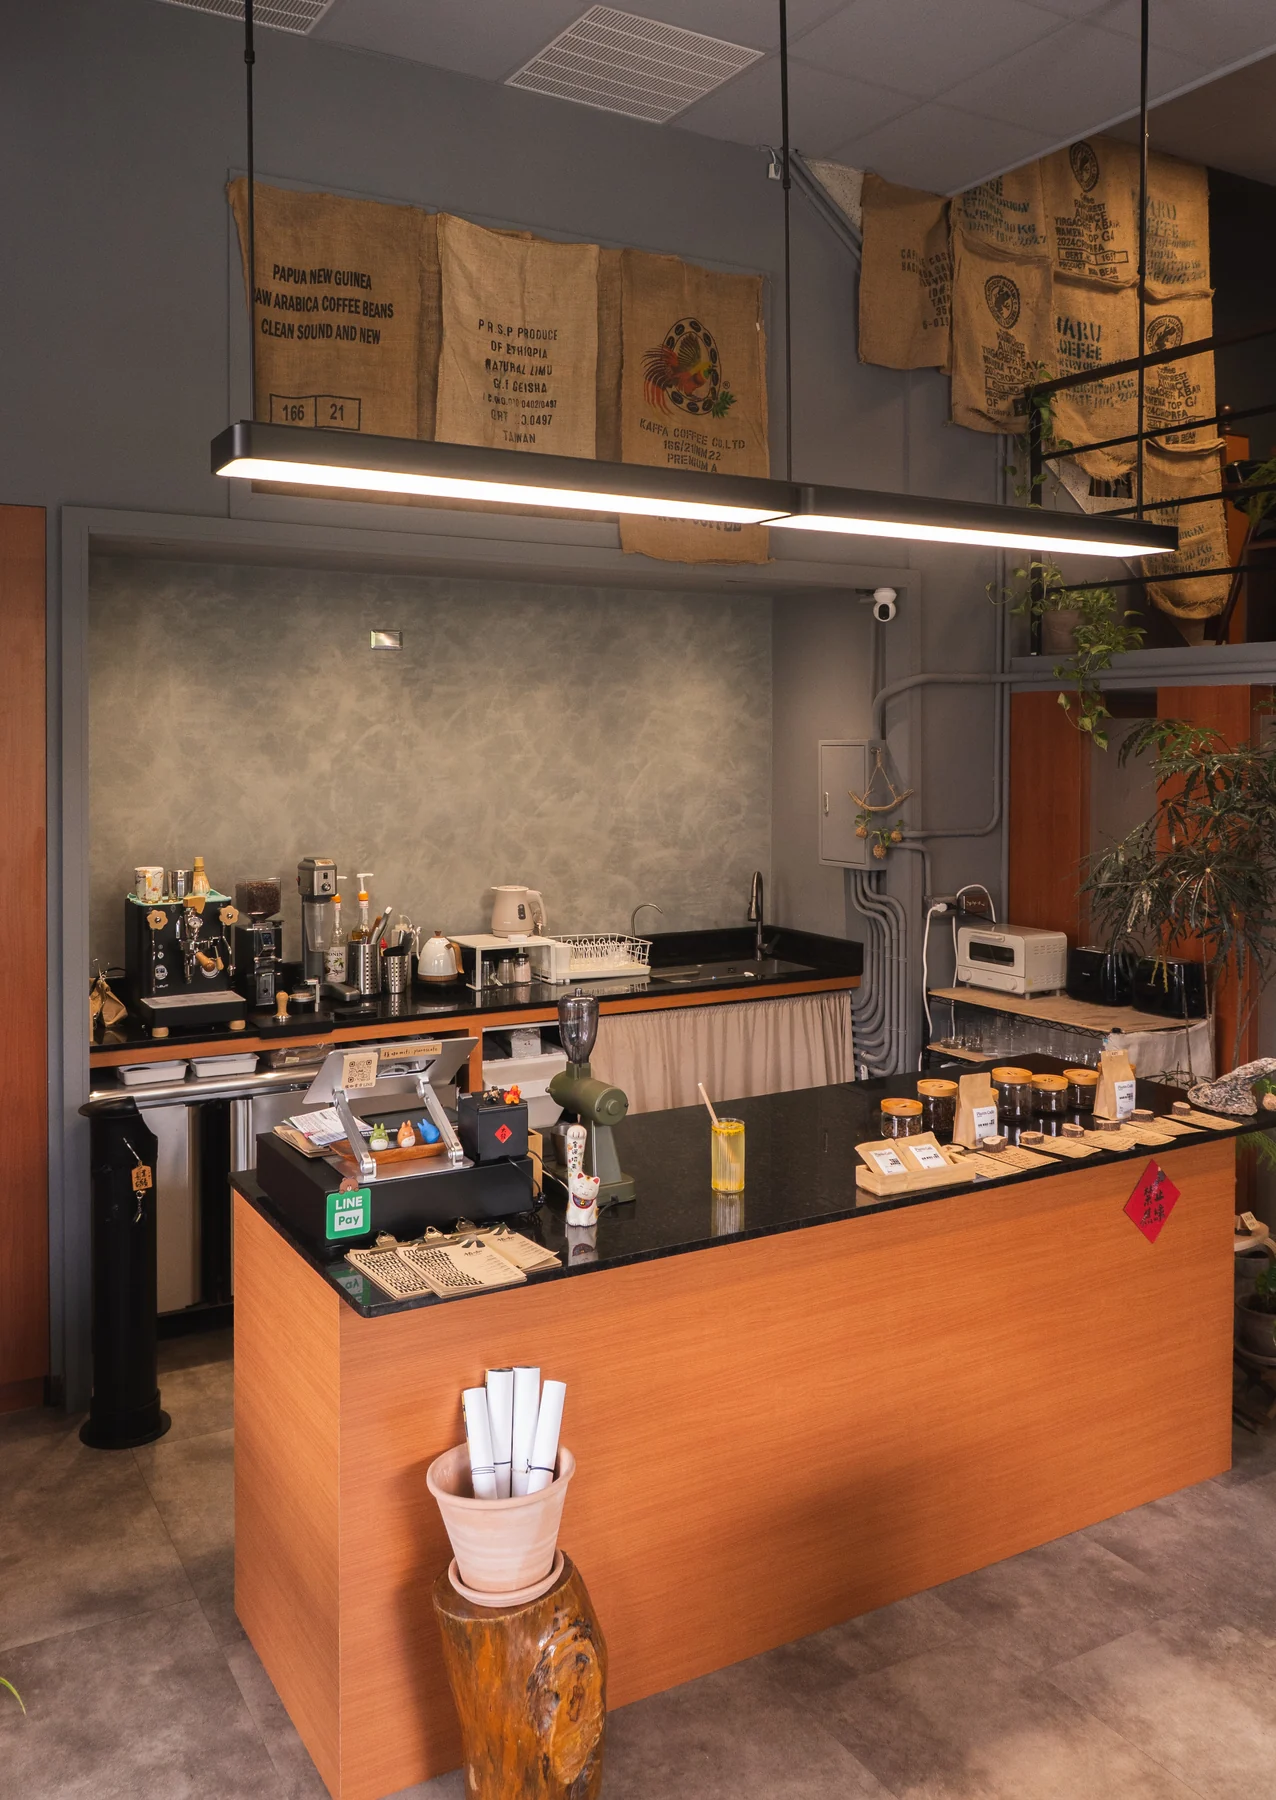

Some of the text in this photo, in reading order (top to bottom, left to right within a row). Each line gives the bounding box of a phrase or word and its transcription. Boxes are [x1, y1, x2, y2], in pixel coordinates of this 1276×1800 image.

[273, 264, 372, 291] PAPUA NEW GUINEA
[273, 293, 319, 313] ARABICA
[321, 295, 361, 315] COFFEE
[362, 300, 394, 319] BEANS
[261, 318, 381, 345] CLEAN SOUND AND NEW
[517, 327, 558, 341] PRODUCE
[490, 340, 548, 359] OF ETHIOPIA
[485, 358, 552, 376] NATURAL LIMU
[512, 381, 547, 393] GEISHA
[986, 398, 999, 408] OF
[1168, 401, 1182, 411] TOP
[282, 403, 344, 422] 166 21
[639, 417, 669, 437] KAFFA
[673, 428, 708, 446] COFFEE
[667, 453, 718, 473] PREMIUM A
[335, 1195, 363, 1211] LINE
[338, 1215, 360, 1226] Pay
